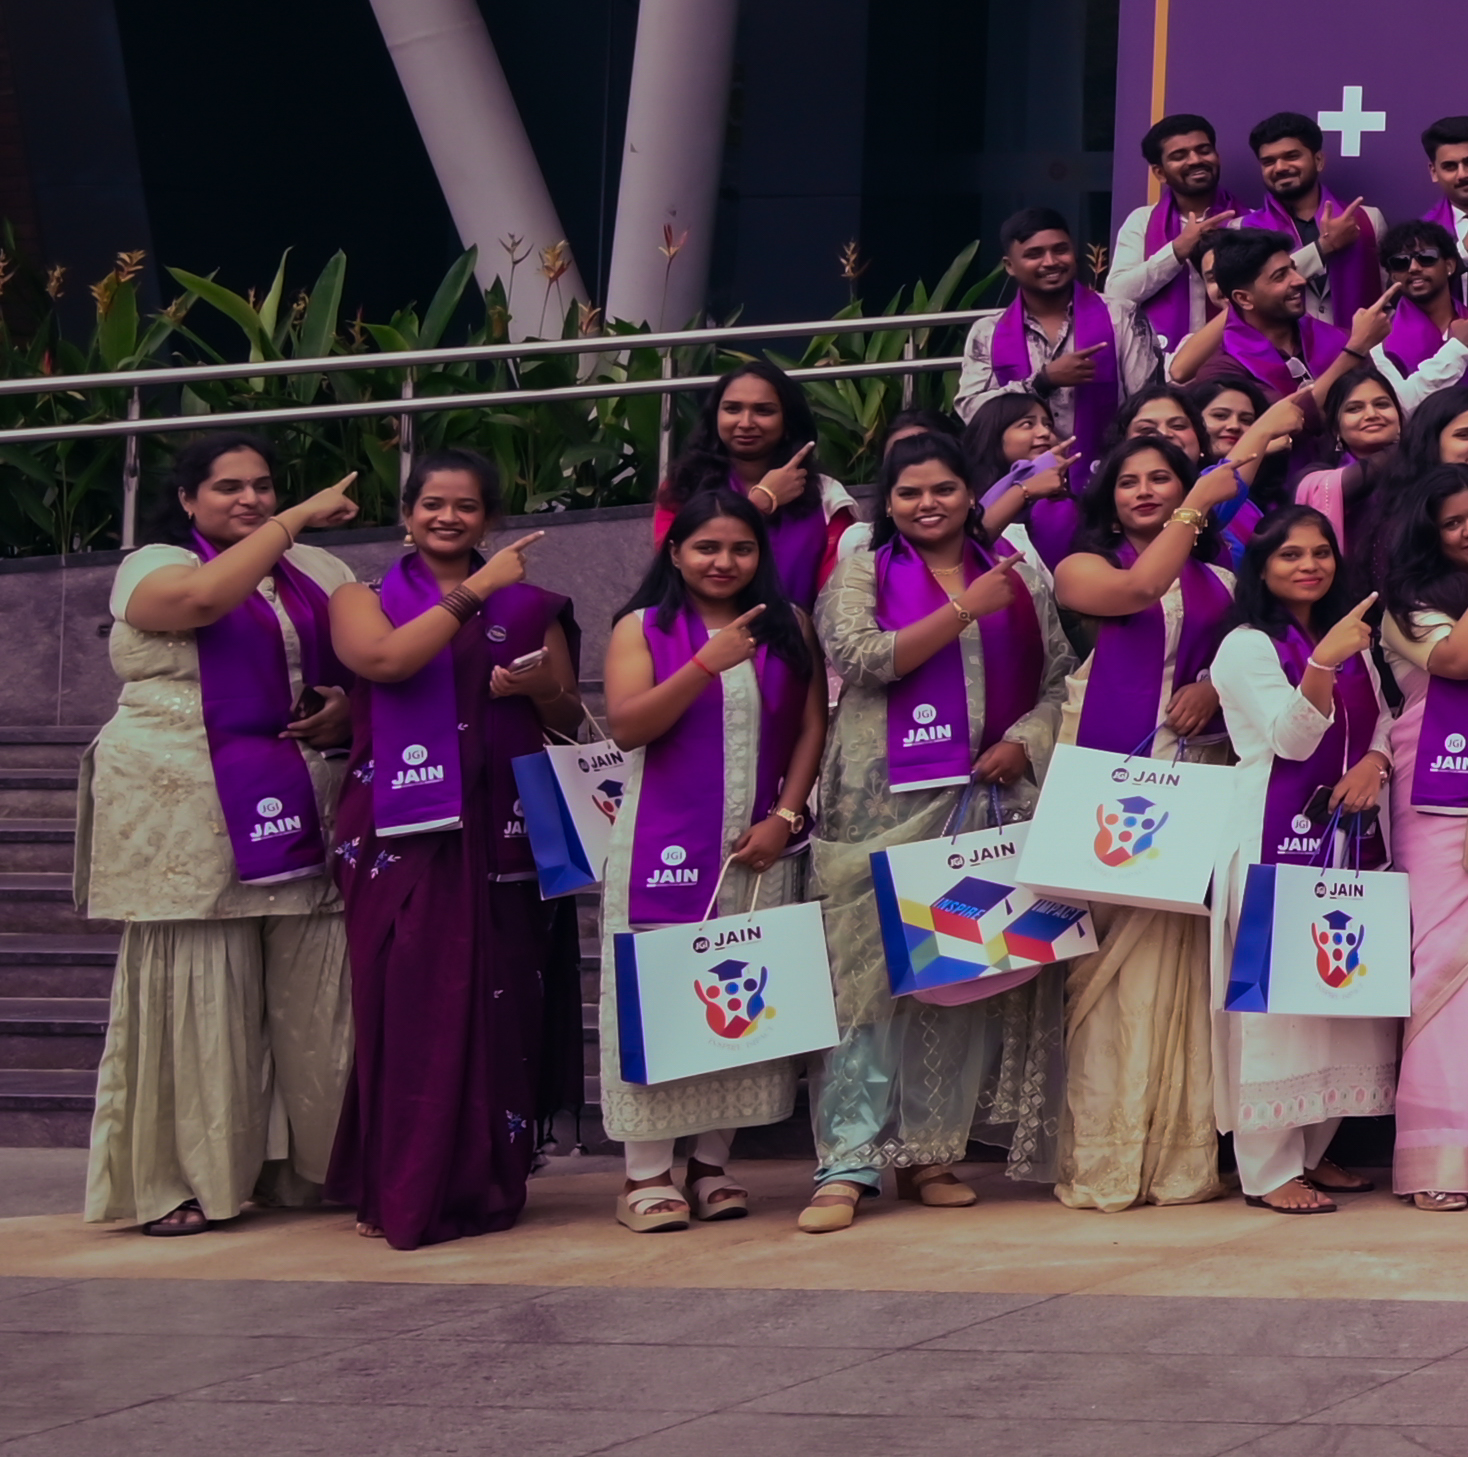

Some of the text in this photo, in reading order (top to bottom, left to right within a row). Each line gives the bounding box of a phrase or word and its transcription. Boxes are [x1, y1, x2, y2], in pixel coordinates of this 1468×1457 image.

[903, 724, 952, 744] JAIN
[590, 751, 624, 770] JAIN
[391, 764, 444, 787] JAIN
[1133, 770, 1181, 788] JAIN
[250, 815, 302, 839] JAIN
[969, 842, 1016, 863] JAIN
[1279, 837, 1321, 853] JAIN
[646, 868, 699, 884] JAIN
[1329, 882, 1364, 899] JAIN
[933, 896, 986, 922] INSPIRE
[1033, 899, 1079, 922] IMPACT
[714, 926, 762, 947] JAIN
